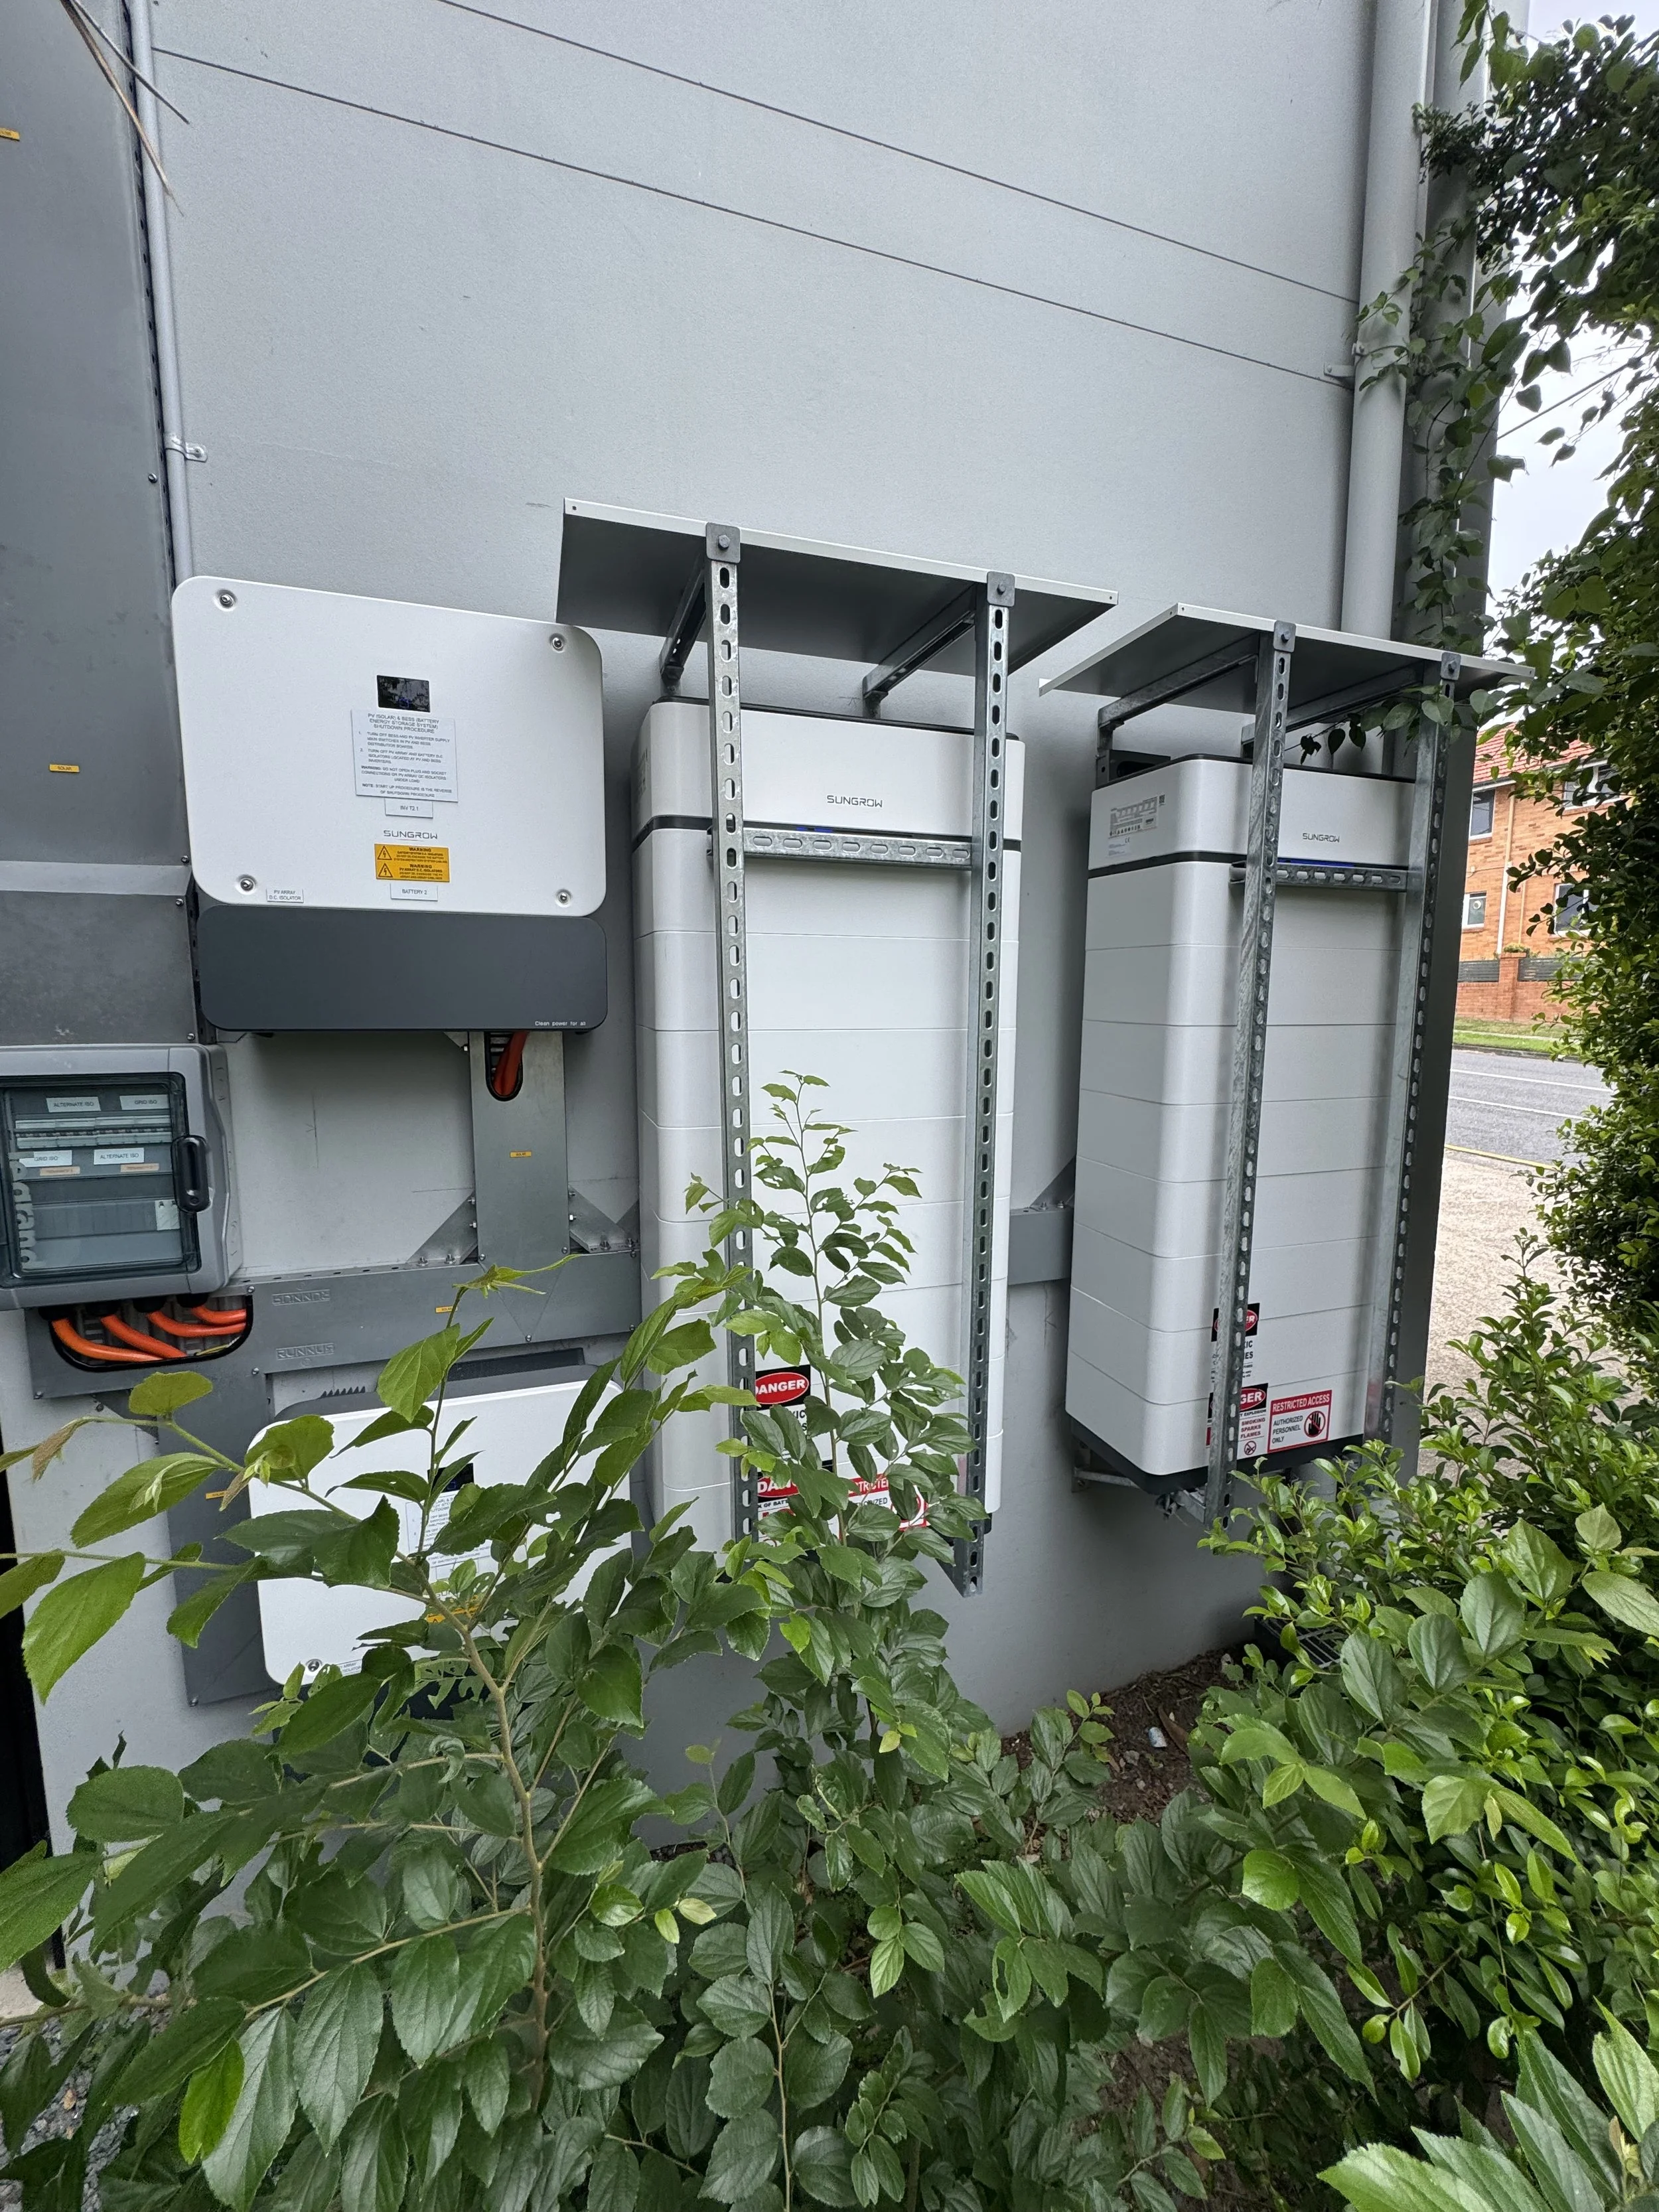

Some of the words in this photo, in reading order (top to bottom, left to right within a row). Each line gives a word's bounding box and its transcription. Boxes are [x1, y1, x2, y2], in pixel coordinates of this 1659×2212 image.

[826, 794, 883, 808] SUNGROW
[383, 830, 438, 840] SUNGROW
[1302, 832, 1340, 843] SUNGROW
[1240, 1391, 1262, 1404] GER
[1272, 1398, 1307, 1412] RESTRICTED
[1307, 1393, 1331, 1406] ACCESS
[1241, 1417, 1266, 1426] SMOKING
[1240, 1424, 1262, 1433] SPARKS
[1272, 1424, 1301, 1435] PERSONNEL
[1271, 1436, 1285, 1444] ONLY
